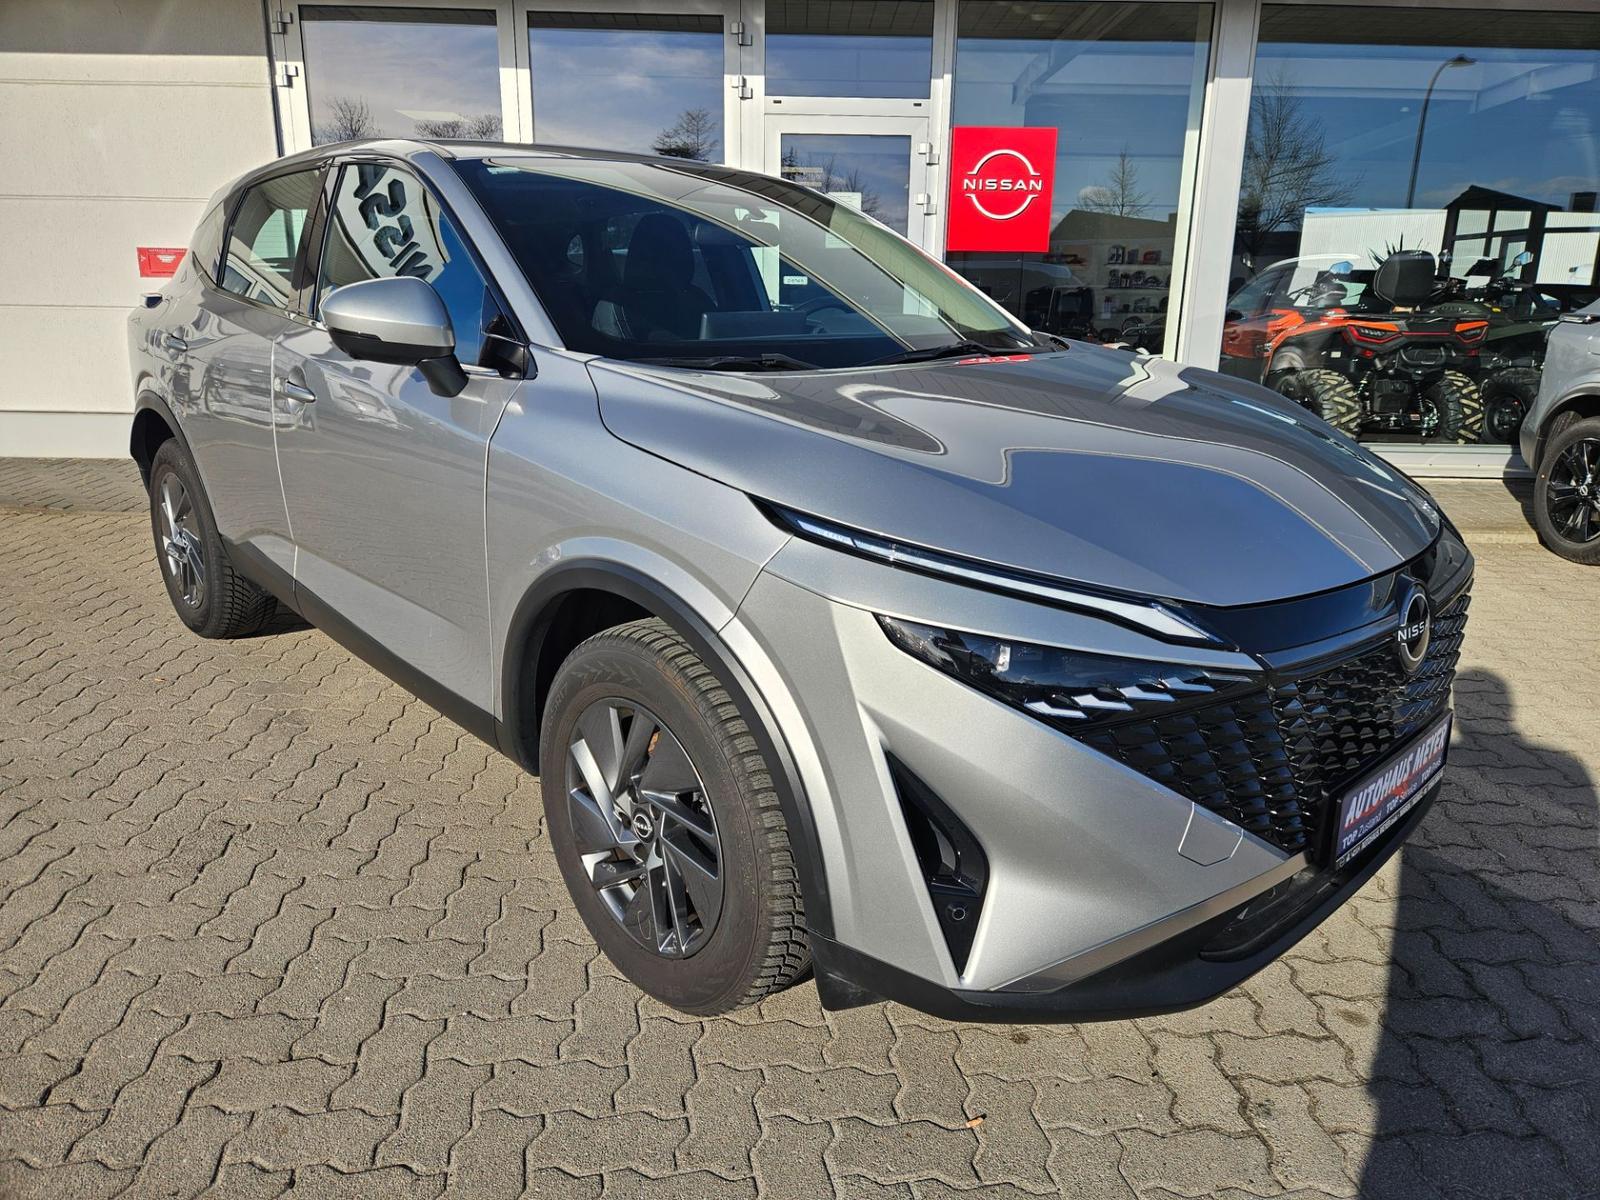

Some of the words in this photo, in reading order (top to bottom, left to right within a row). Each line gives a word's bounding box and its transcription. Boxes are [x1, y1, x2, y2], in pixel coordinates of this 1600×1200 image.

[963, 178, 1042, 191] NISSAN
[1397, 621, 1426, 641] NISS
[1344, 753, 1414, 828] AUTOHAUS
[1343, 830, 1358, 849] TOP
